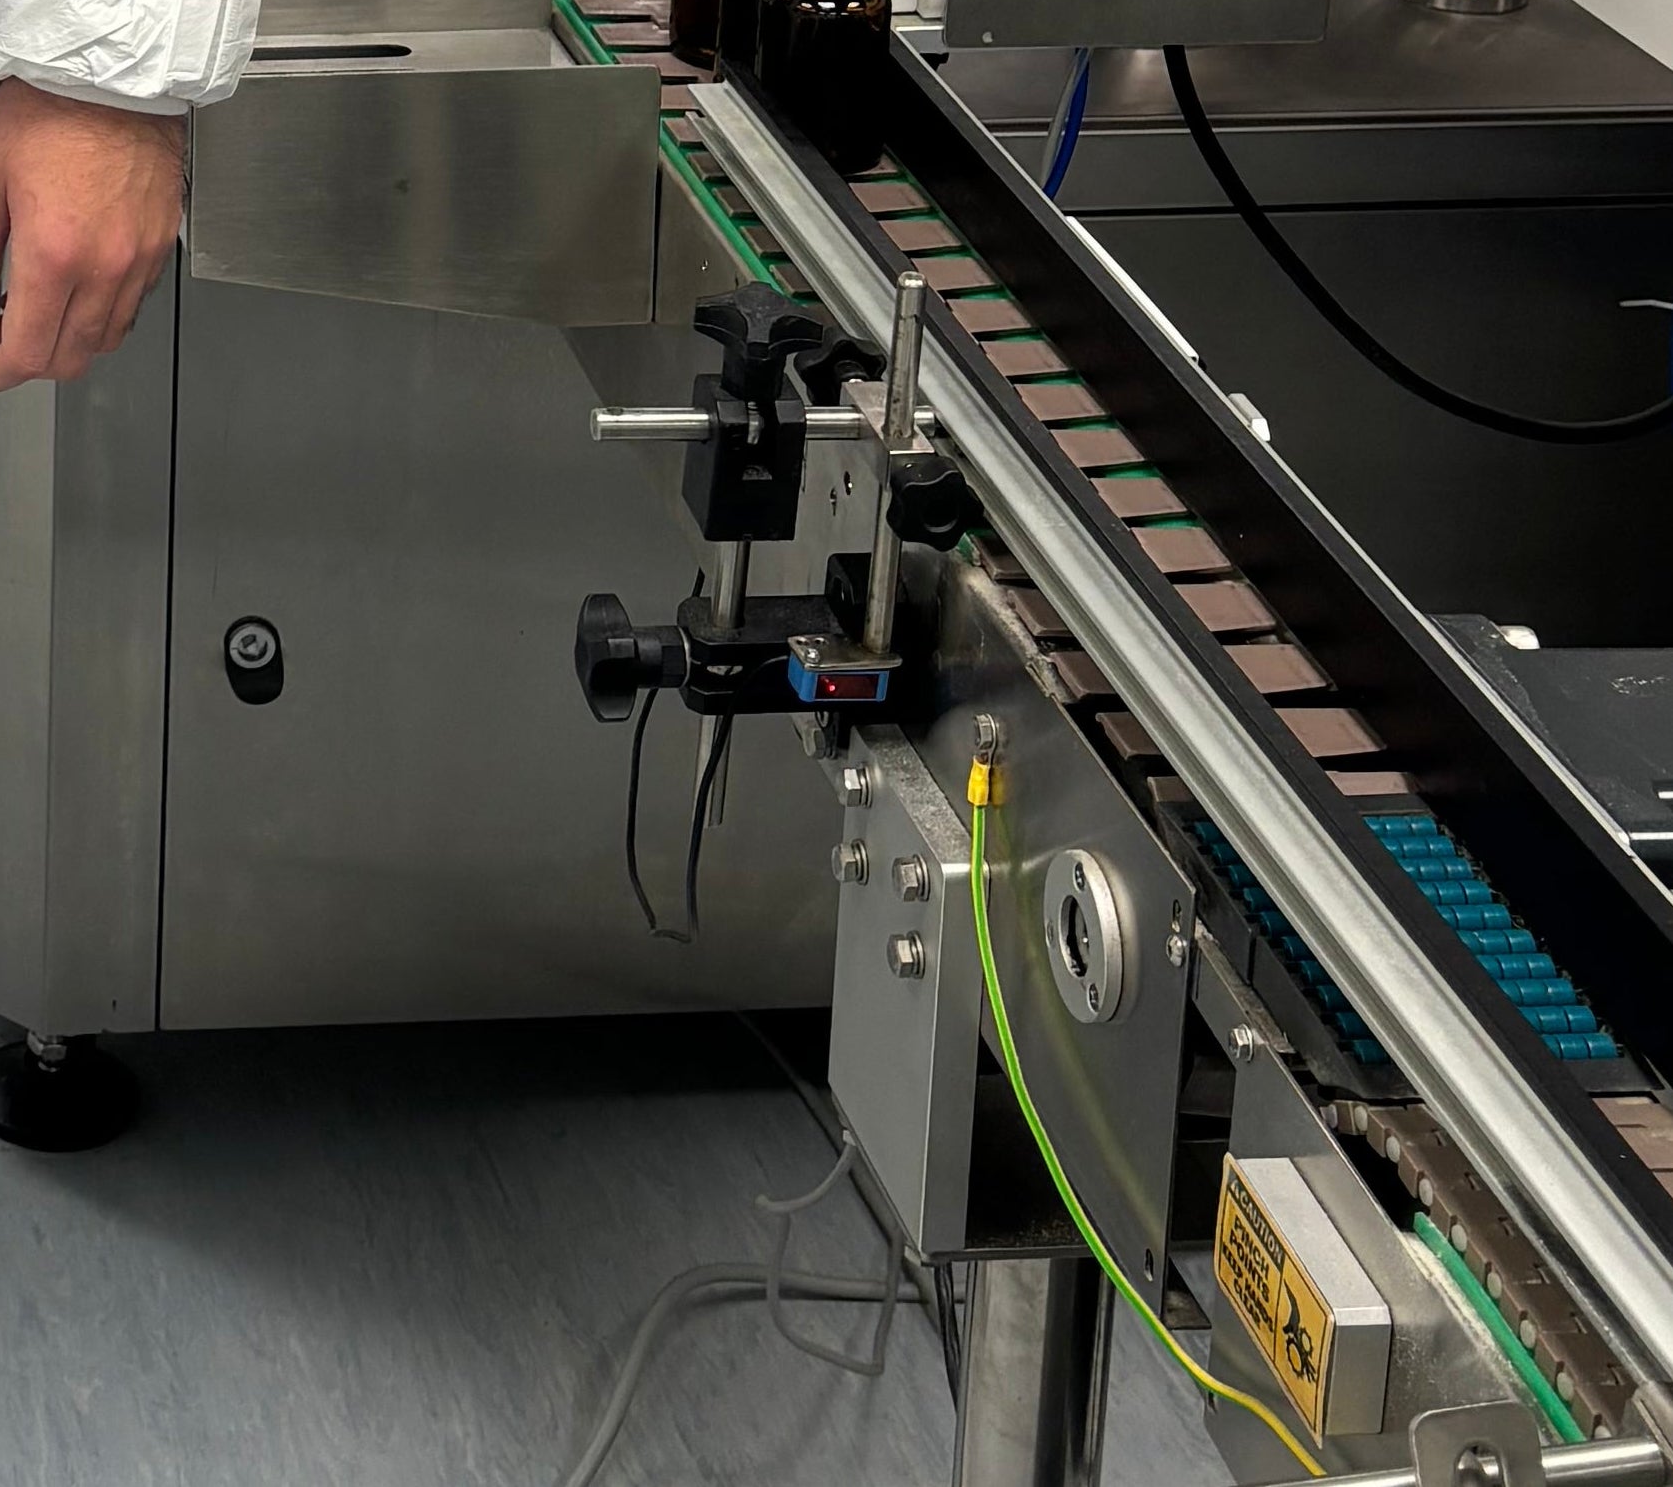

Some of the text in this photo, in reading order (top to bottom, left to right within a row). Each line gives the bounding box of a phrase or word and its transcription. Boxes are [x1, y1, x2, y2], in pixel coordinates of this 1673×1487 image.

[1233, 1214, 1269, 1281] PINCH
[1239, 1190, 1283, 1264] CAUTION
[1229, 1229, 1270, 1304] POINTS
